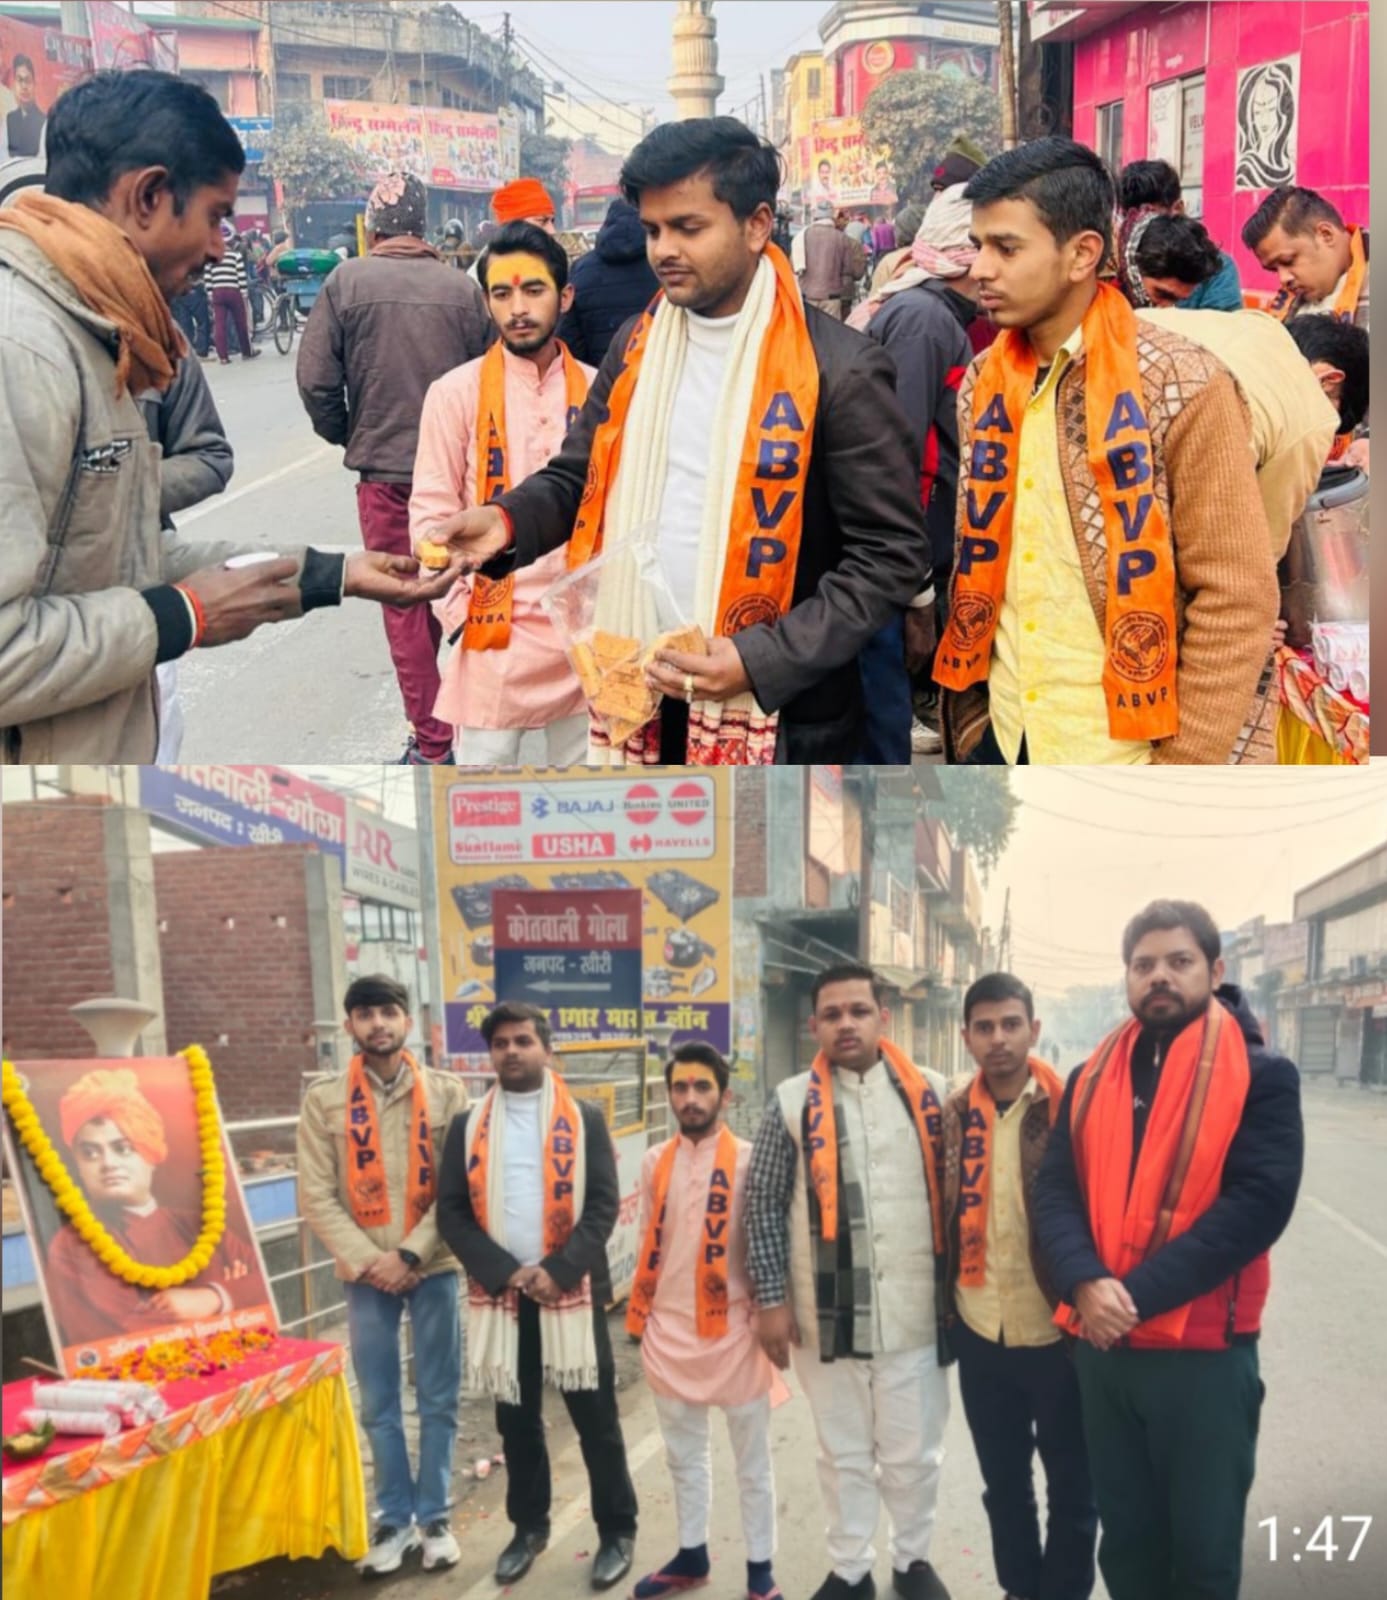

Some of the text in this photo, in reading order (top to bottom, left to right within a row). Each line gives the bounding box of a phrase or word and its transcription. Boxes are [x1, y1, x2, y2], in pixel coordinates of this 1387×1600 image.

[745, 391, 805, 579] ABVP
[958, 393, 1014, 576] ABVP
[1103, 390, 1158, 596] ABVP
[1117, 687, 1167, 708] ABVP
[352, 819, 399, 873] RR
[455, 796, 518, 816] Prestige
[557, 800, 614, 814] BAJAJ
[667, 798, 710, 809] UNITED
[542, 834, 606, 856] USHA
[654, 836, 711, 849] HAVELLS
[506, 904, 630, 942] कोतवाली गोला
[523, 954, 567, 974] जनपद
[580, 950, 613, 974] खीरी
[350, 1087, 376, 1170] ABVP
[552, 1116, 574, 1200] ABVP
[960, 1108, 987, 1217] ABVP
[704, 1168, 729, 1265] ABVP
